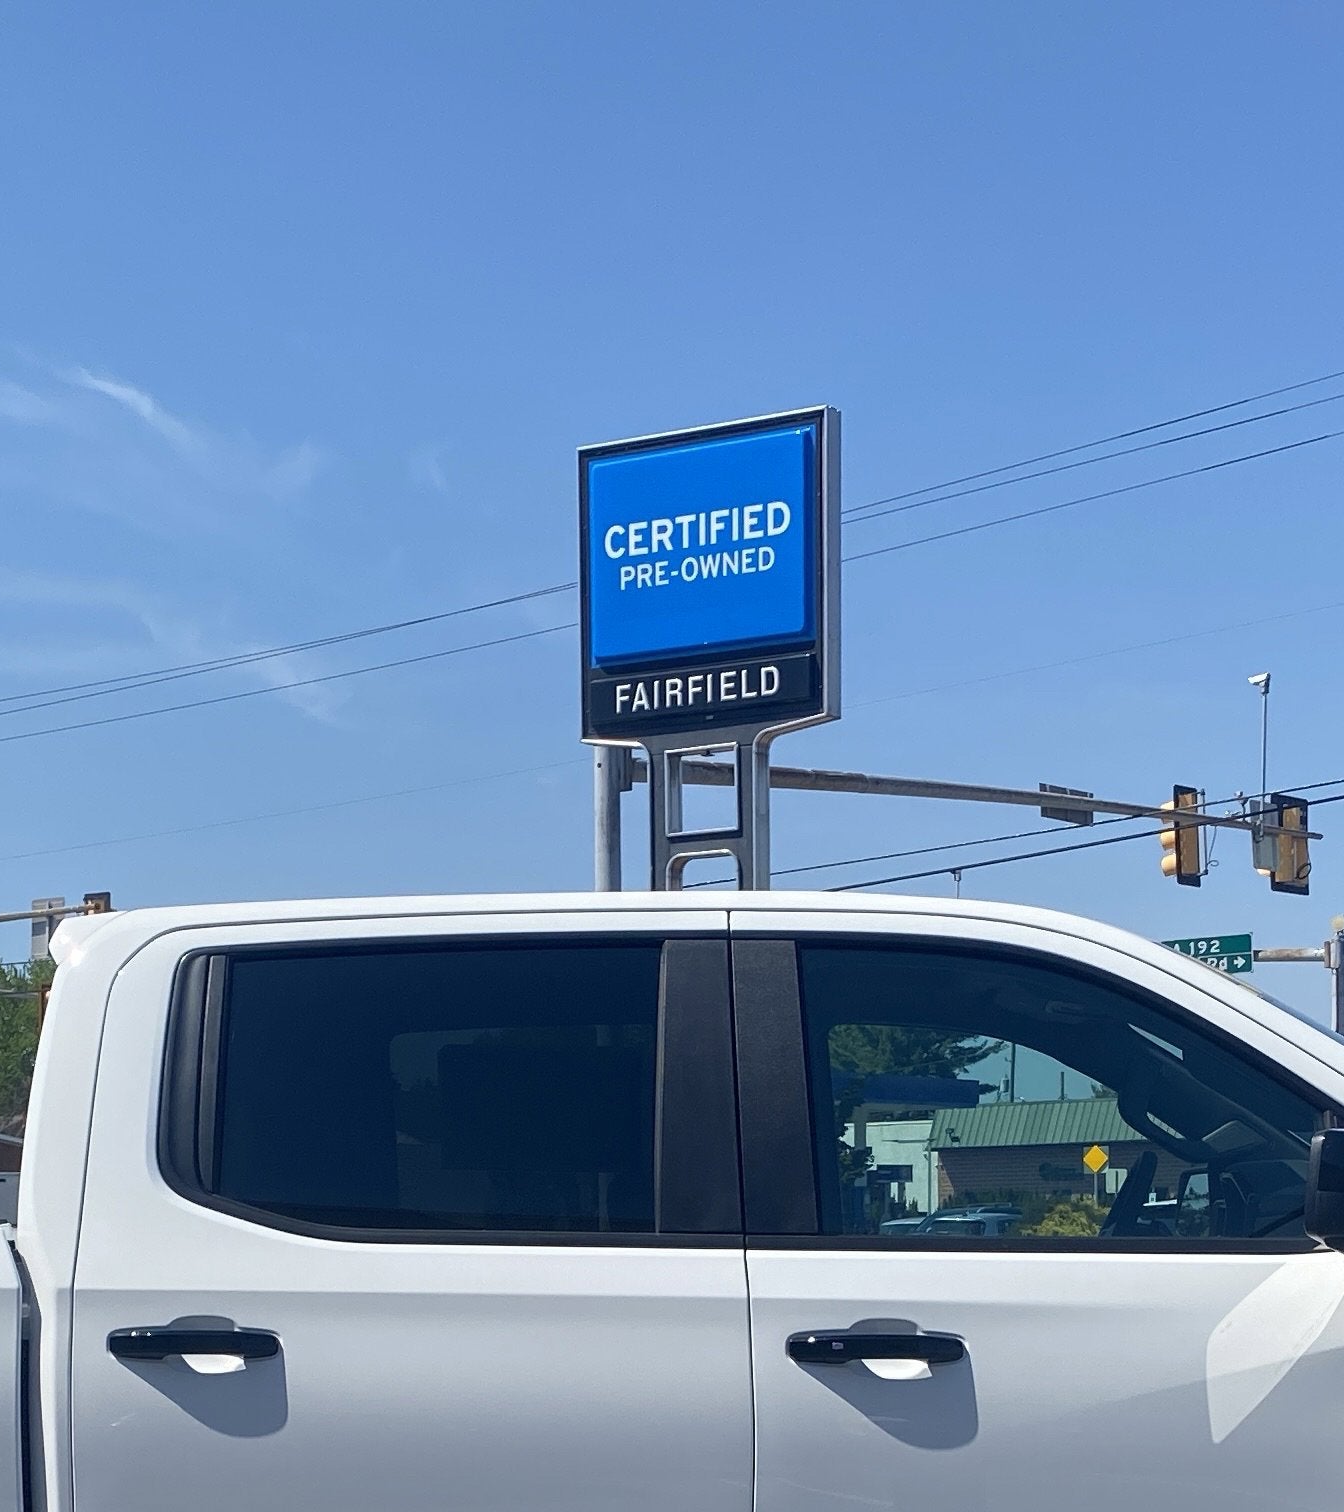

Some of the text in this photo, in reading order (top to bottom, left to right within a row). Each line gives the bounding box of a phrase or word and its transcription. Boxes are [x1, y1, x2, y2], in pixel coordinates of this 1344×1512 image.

[604, 501, 791, 559] CERTIFIED
[620, 546, 775, 590] PRE-OWNED
[615, 665, 780, 714] FAIRFIELD
[1188, 940, 1220, 957] 192
